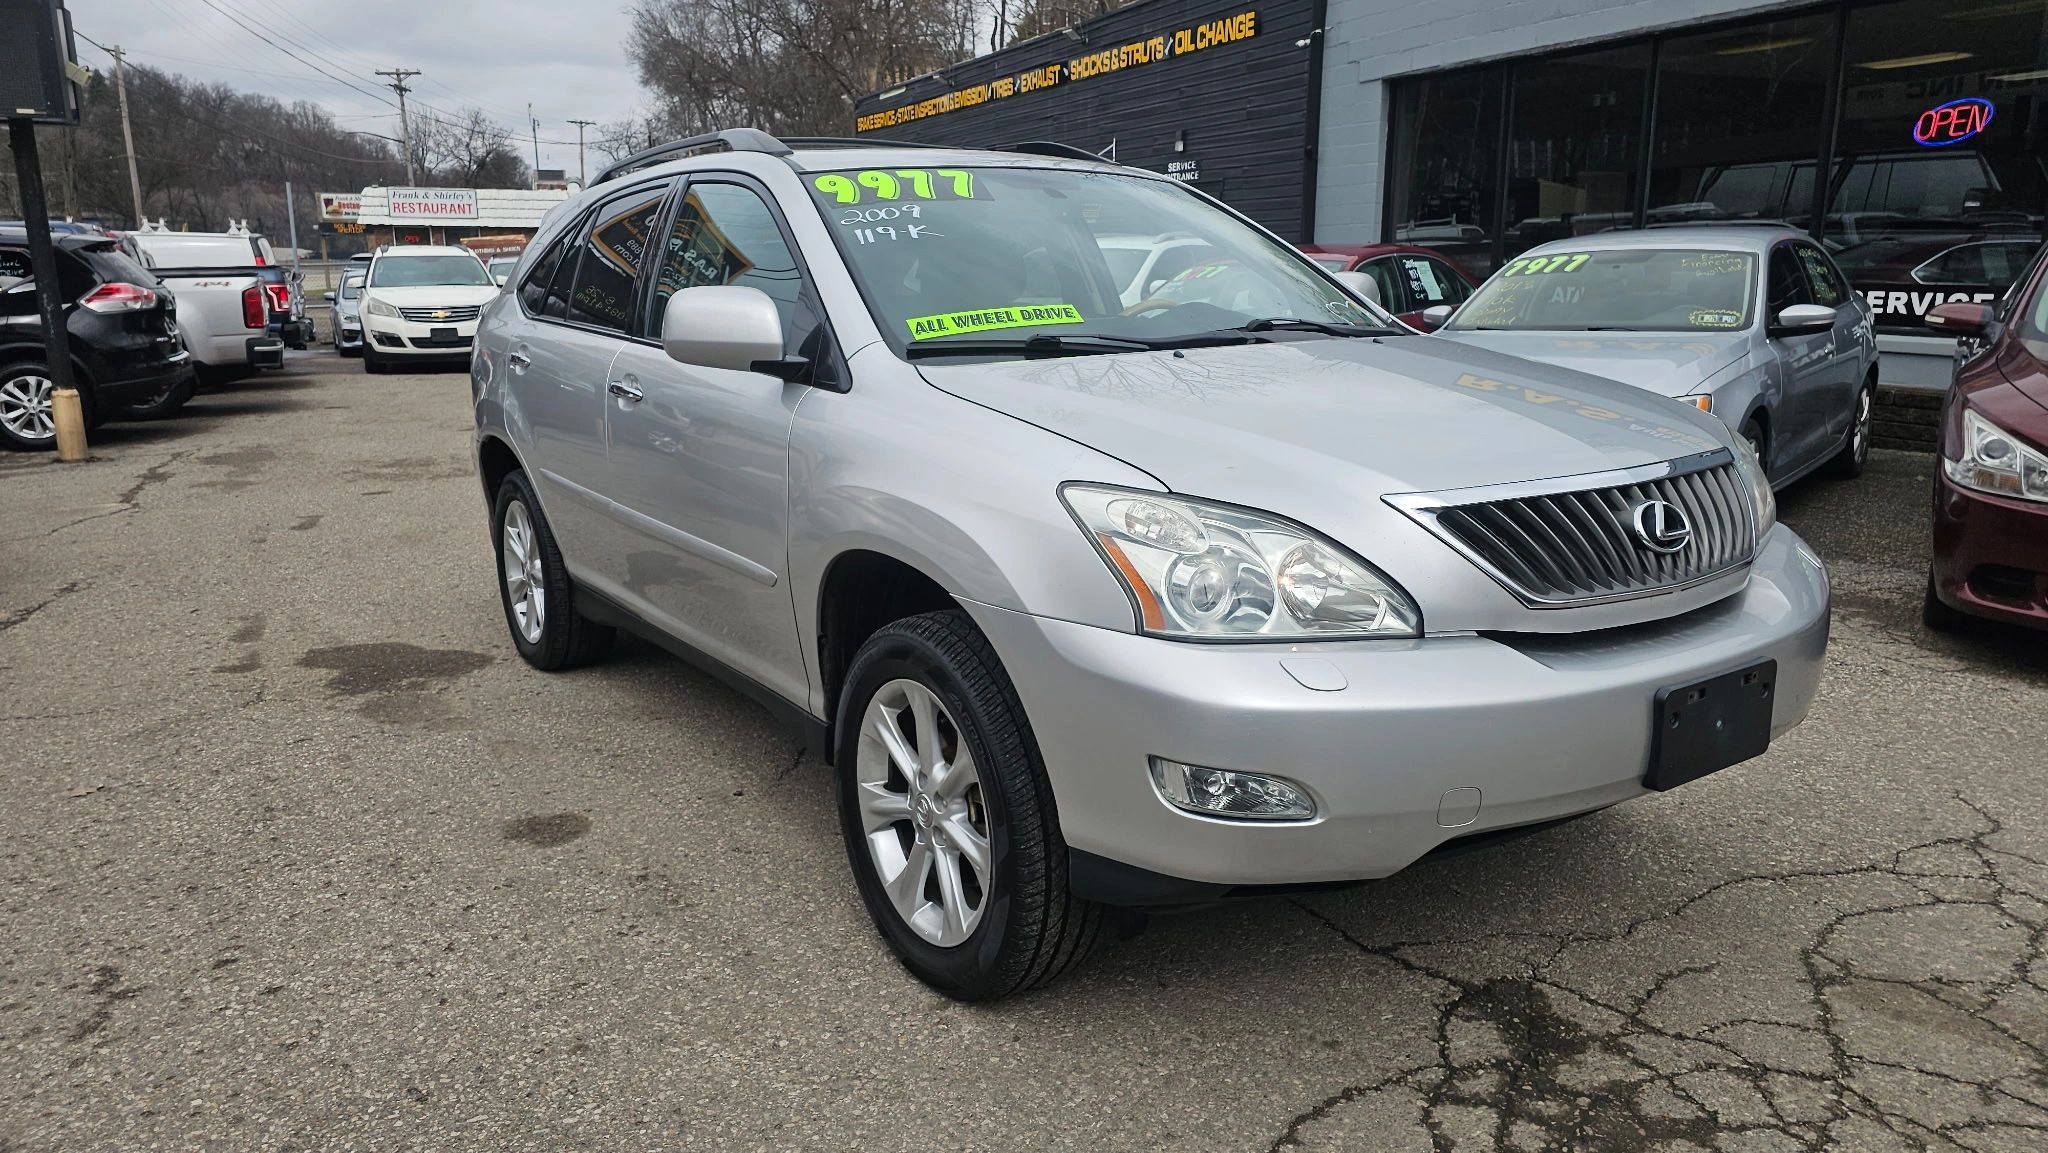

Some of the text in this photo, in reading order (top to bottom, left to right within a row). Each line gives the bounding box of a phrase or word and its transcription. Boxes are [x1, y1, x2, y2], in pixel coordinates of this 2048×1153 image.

[857, 114, 874, 133] BRAKE
[873, 109, 896, 129] SERVICE
[898, 105, 915, 124] STATE
[914, 94, 950, 119] INSPECTION
[954, 84, 988, 108] EMISSION
[992, 77, 1013, 100] TIRES
[1021, 64, 1060, 93] EXHAUST
[1070, 51, 1110, 80] SHOCKS
[1111, 48, 1119, 70] &
[1120, 36, 1163, 68] STRUTS
[1174, 29, 1196, 55] OIL
[1197, 11, 1256, 49] CHANGE
[1916, 104, 1989, 141] OPEN
[1164, 171, 1200, 181] NTRANCE
[1167, 160, 1197, 173] SERVICE
[392, 191, 472, 202] Frank & Shirley's
[814, 169, 974, 204] 9977
[393, 202, 473, 215] RESTAURANT
[840, 204, 921, 225] 2009
[1504, 254, 1591, 277] 7977
[915, 307, 1076, 335] ALL WHEEL DRIVE
